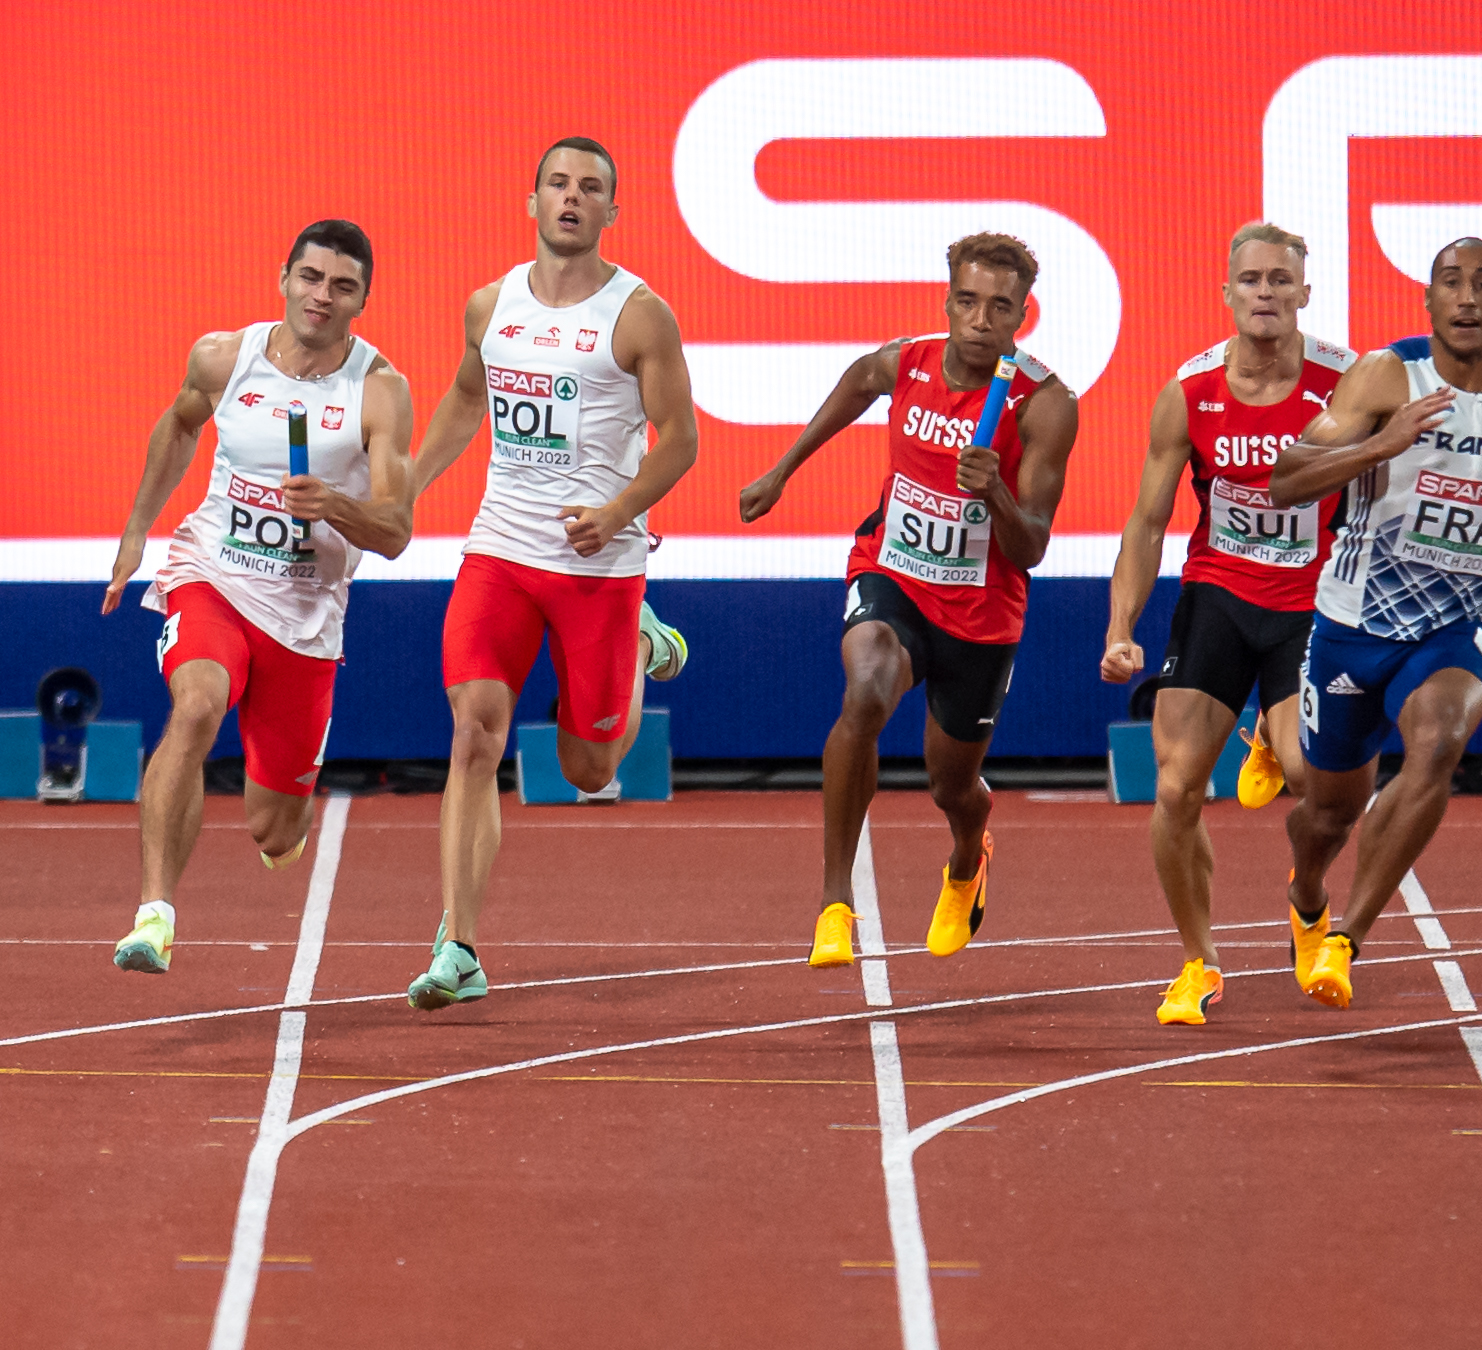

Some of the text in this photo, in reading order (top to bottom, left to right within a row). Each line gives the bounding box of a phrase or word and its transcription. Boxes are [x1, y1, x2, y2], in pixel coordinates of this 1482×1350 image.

[489, 368, 551, 395] SPAR
[494, 395, 567, 440] POL
[494, 441, 571, 465] MUNICH 2022
[230, 478, 286, 510] SPA
[896, 481, 959, 519] SPAR
[1215, 480, 1274, 507] SPA
[900, 512, 968, 558] SUI
[1228, 506, 1298, 543] SUI
[220, 547, 316, 578] MUNICH 2022
[1215, 535, 1270, 560] MUNICH
[1274, 551, 1310, 564] 2022
[1403, 542, 1461, 567] MUNICH
[886, 550, 978, 582] MUNICH 2022
[1303, 686, 1312, 718] 6
